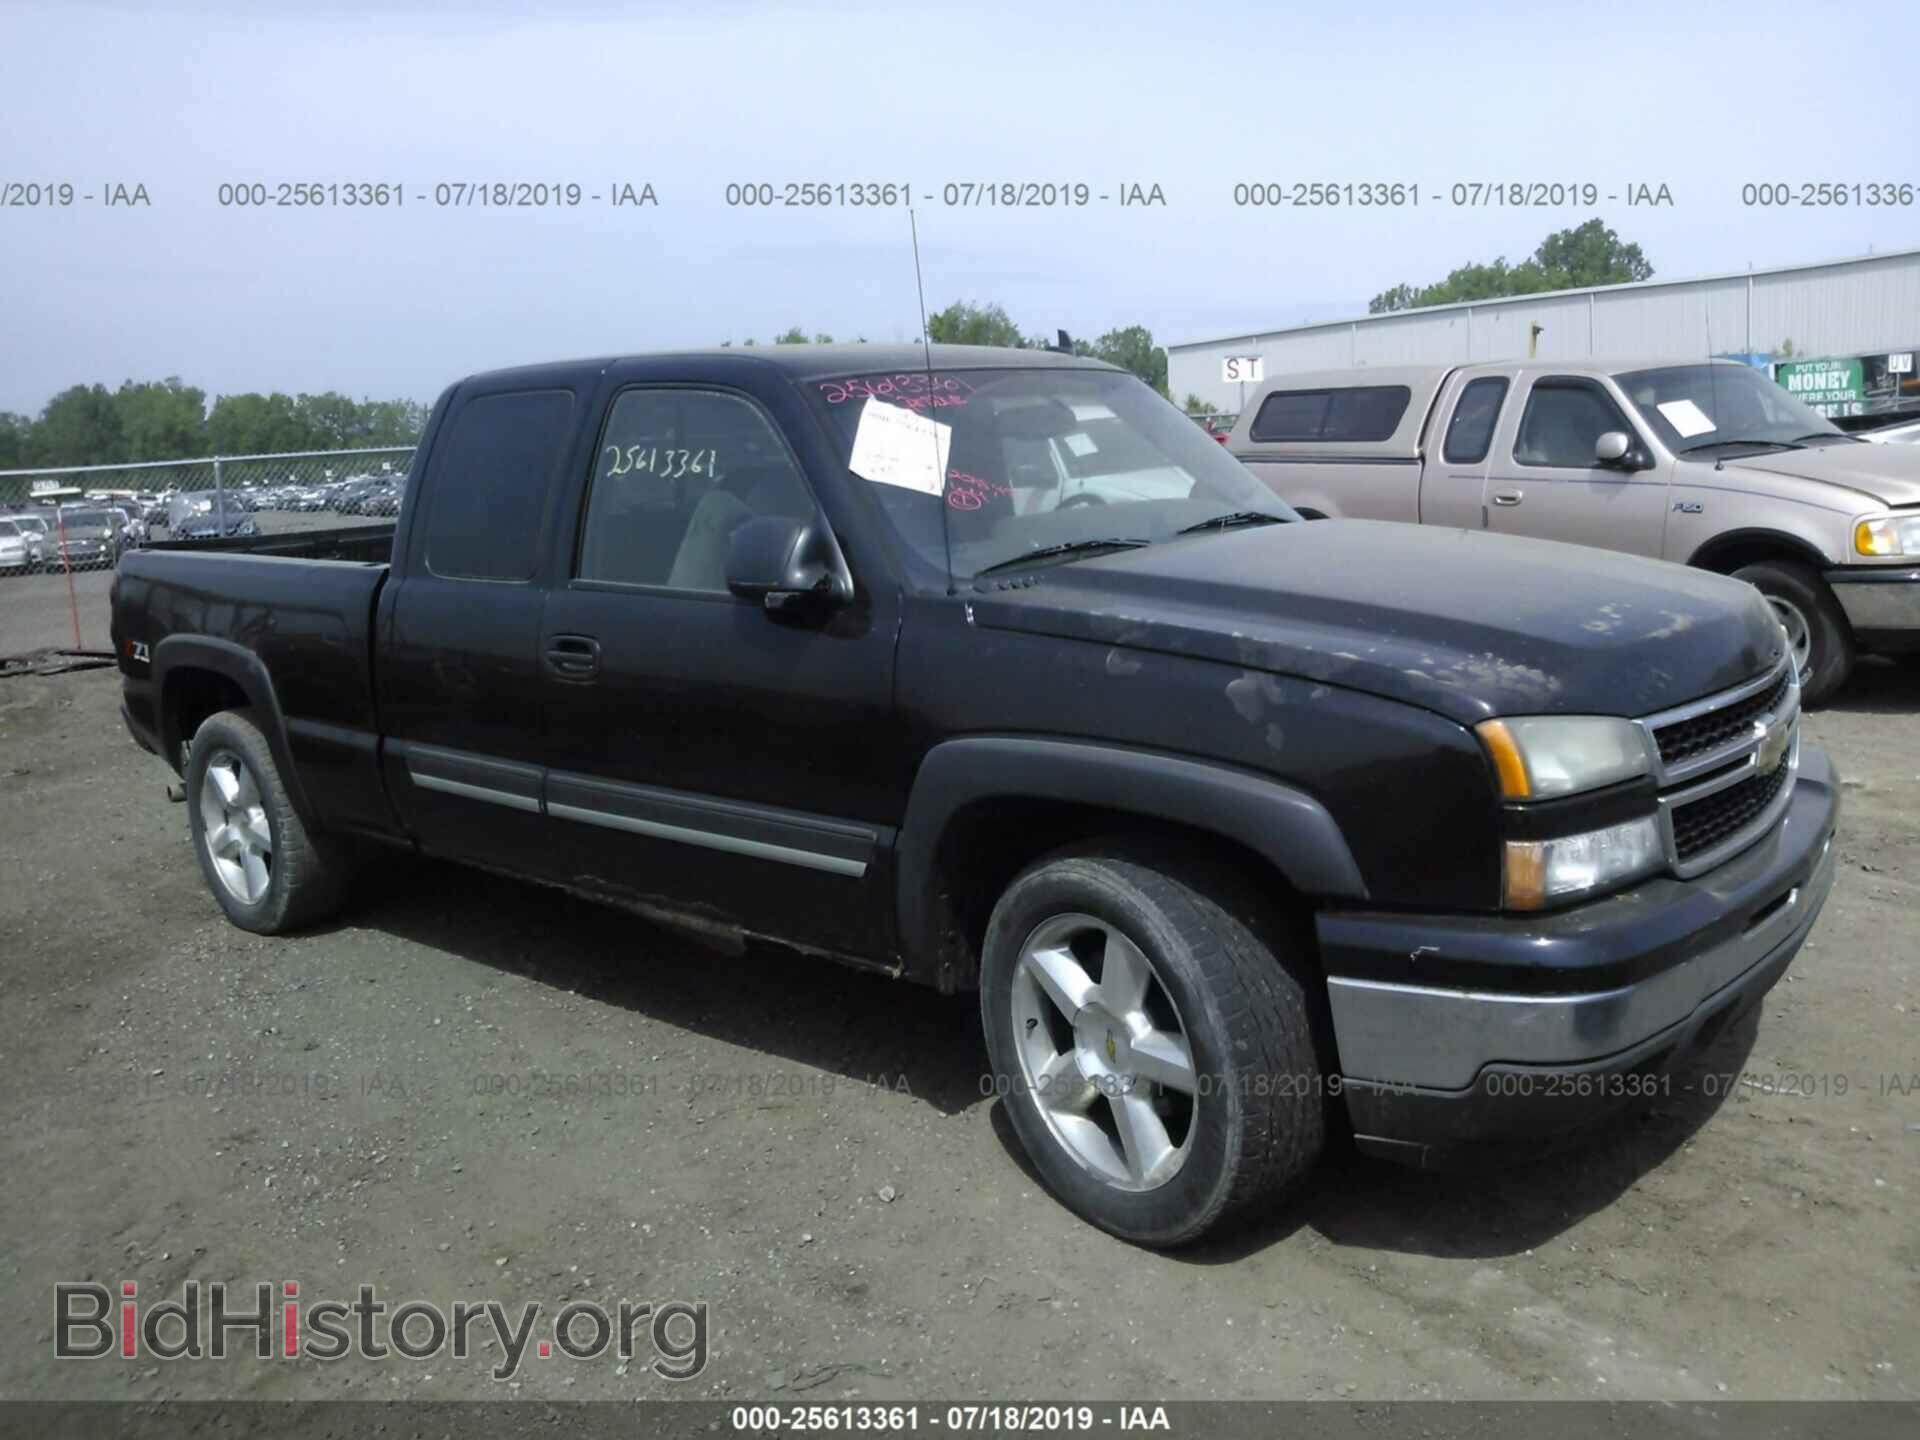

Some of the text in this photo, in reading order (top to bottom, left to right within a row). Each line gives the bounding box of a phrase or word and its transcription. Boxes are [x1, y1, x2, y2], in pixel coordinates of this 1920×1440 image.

[1788, 369, 1850, 391] MONEY
[1827, 390, 1857, 400] YOUR
[606, 445, 716, 478] 25613361
